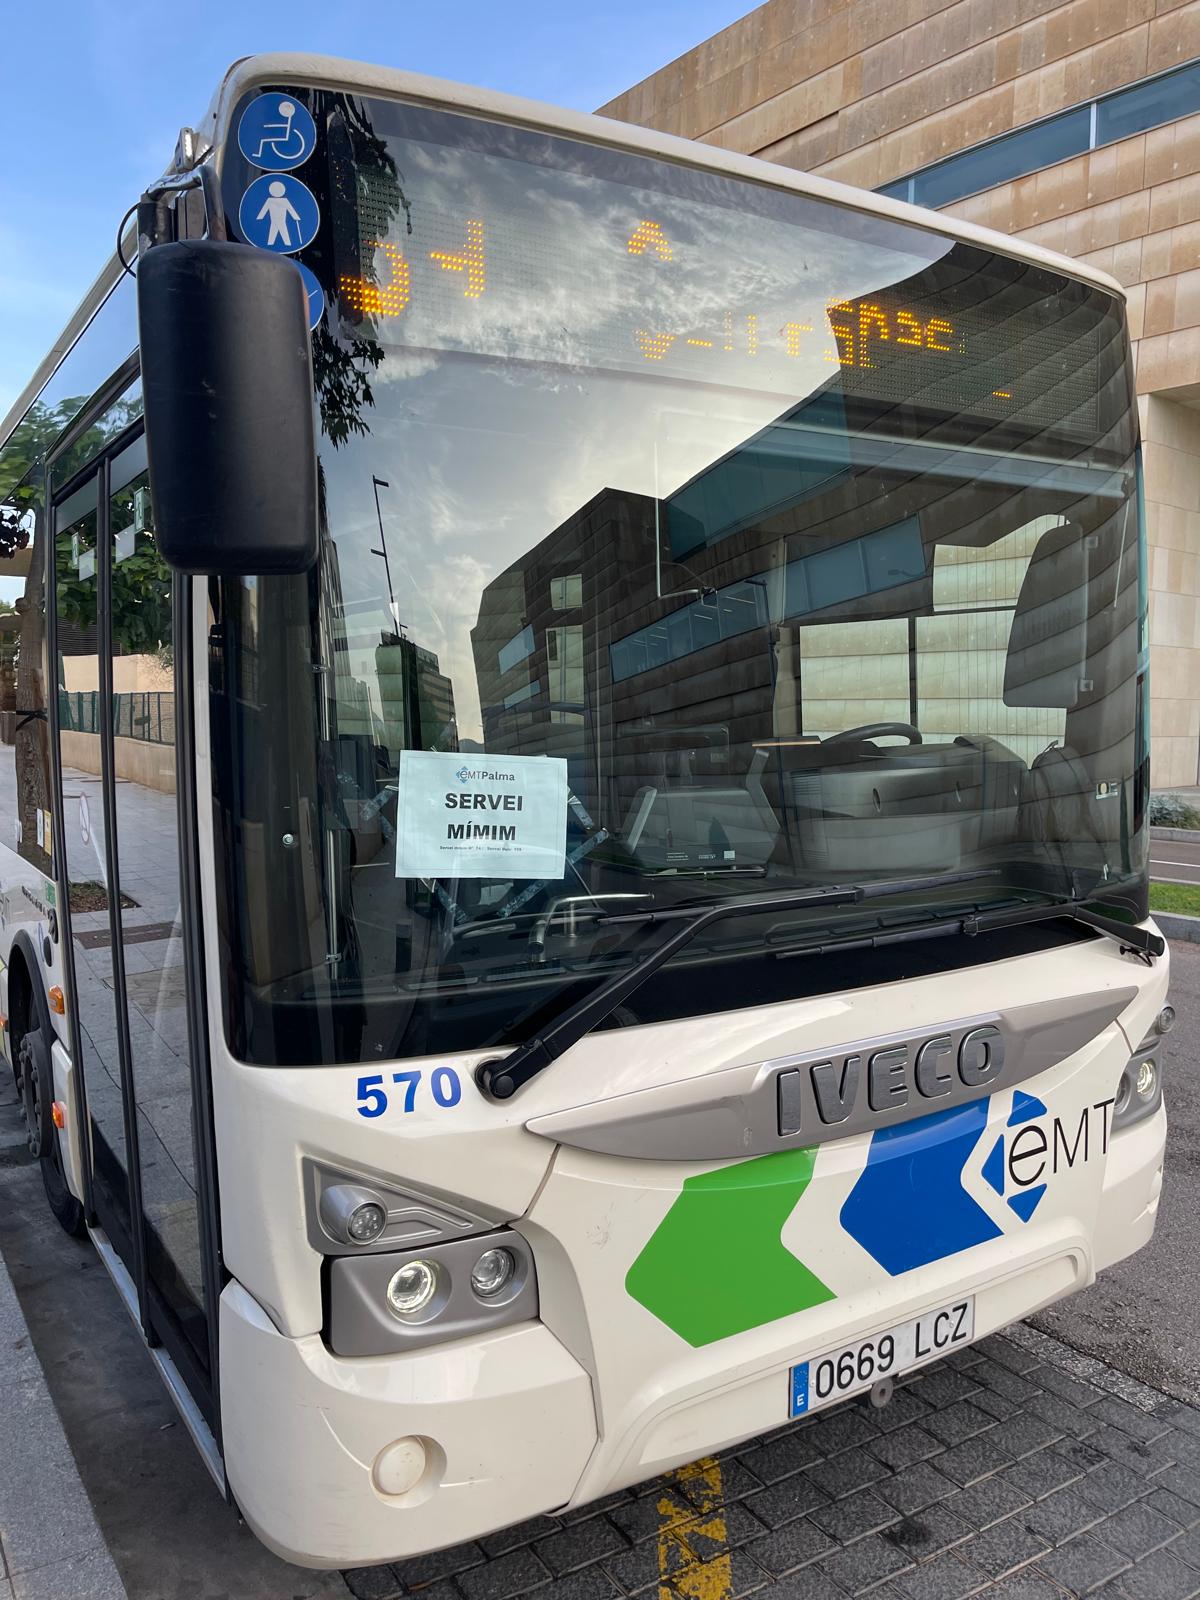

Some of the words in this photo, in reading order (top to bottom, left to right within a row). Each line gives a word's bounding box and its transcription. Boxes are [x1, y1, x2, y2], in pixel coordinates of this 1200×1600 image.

[444, 792, 523, 811] SERVEI
[357, 1066, 461, 1118] 570
[777, 1025, 1005, 1136] IVECO
[1008, 1097, 1115, 1186] eMT
[815, 1335, 895, 1398] 0669
[915, 1302, 968, 1358] LCZ
[796, 1393, 805, 1406] E
